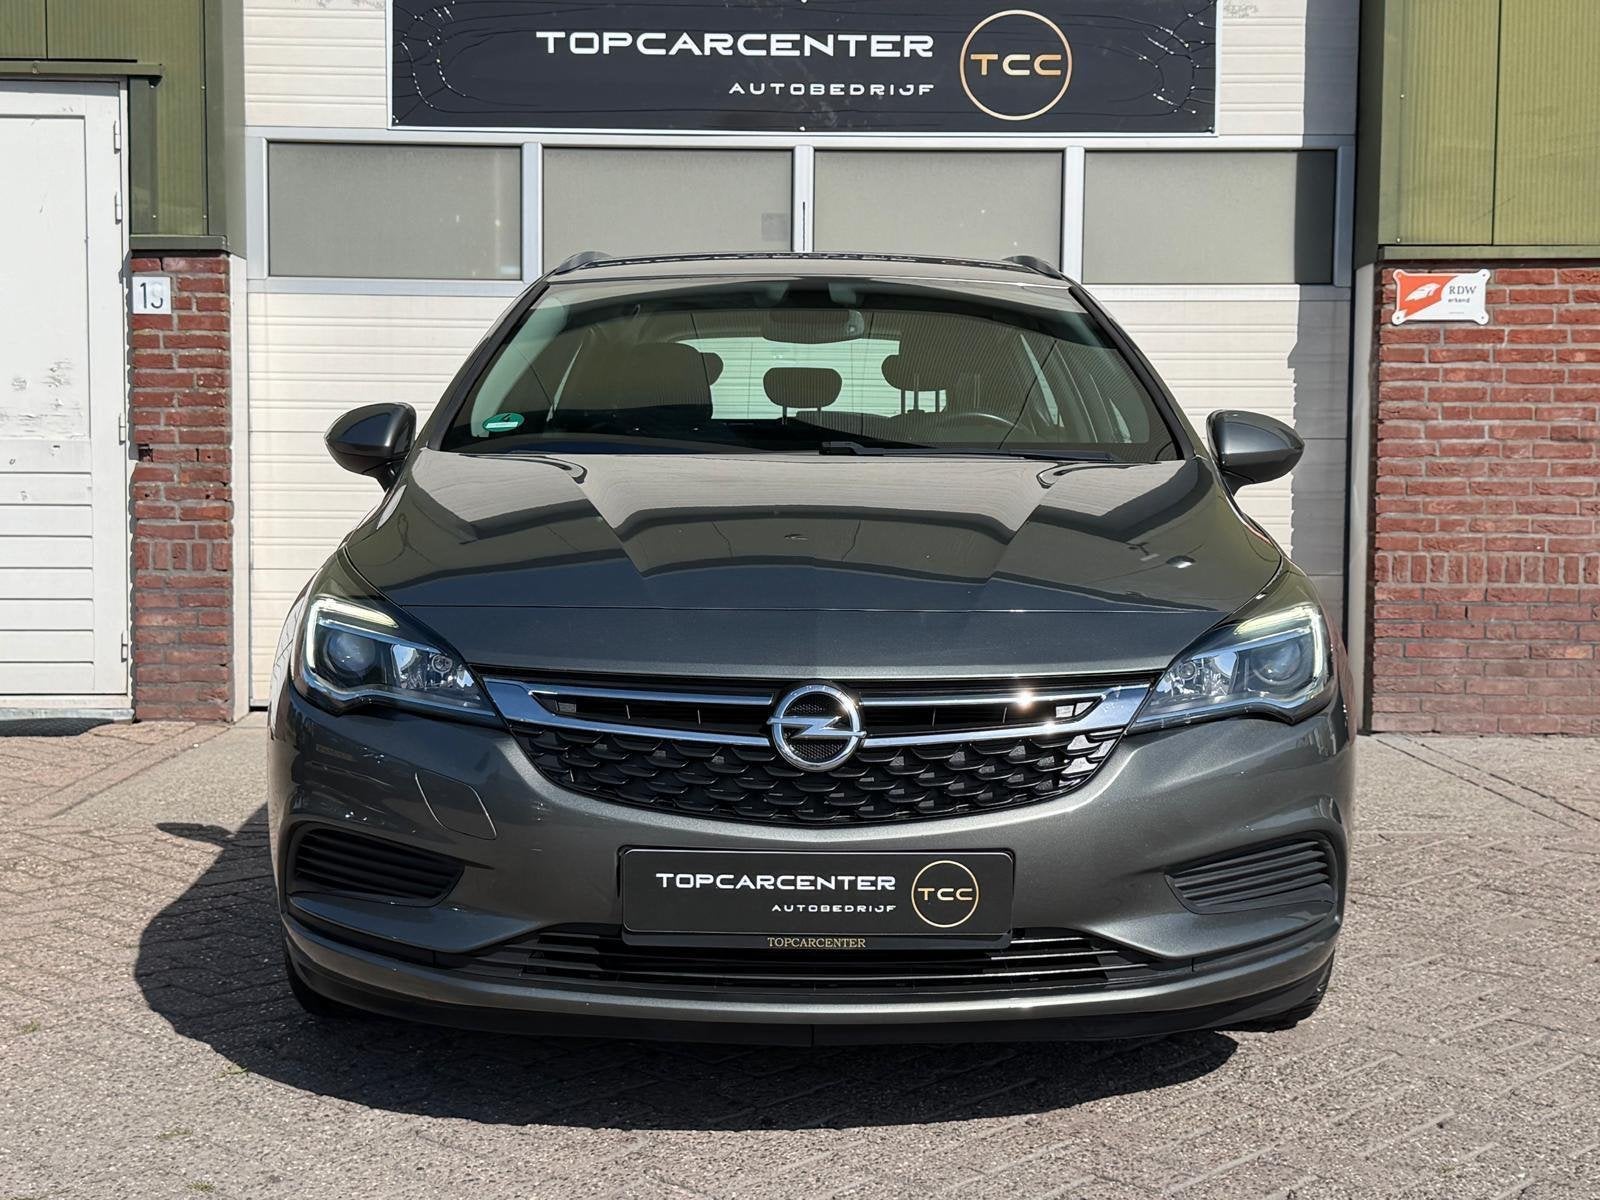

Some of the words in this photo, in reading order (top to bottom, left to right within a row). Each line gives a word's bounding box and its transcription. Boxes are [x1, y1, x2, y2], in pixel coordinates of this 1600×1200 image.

[535, 31, 934, 58] TOPCARCENTER
[971, 54, 1062, 75] TCC
[728, 82, 935, 97] AUTOBEDRIJF
[1449, 286, 1476, 295] RDW
[655, 872, 896, 891] TOPCARCENTER
[917, 888, 974, 901] TCC
[771, 904, 897, 913] AUTOBEDRIJF
[767, 936, 867, 949] TOPCARCENTER
